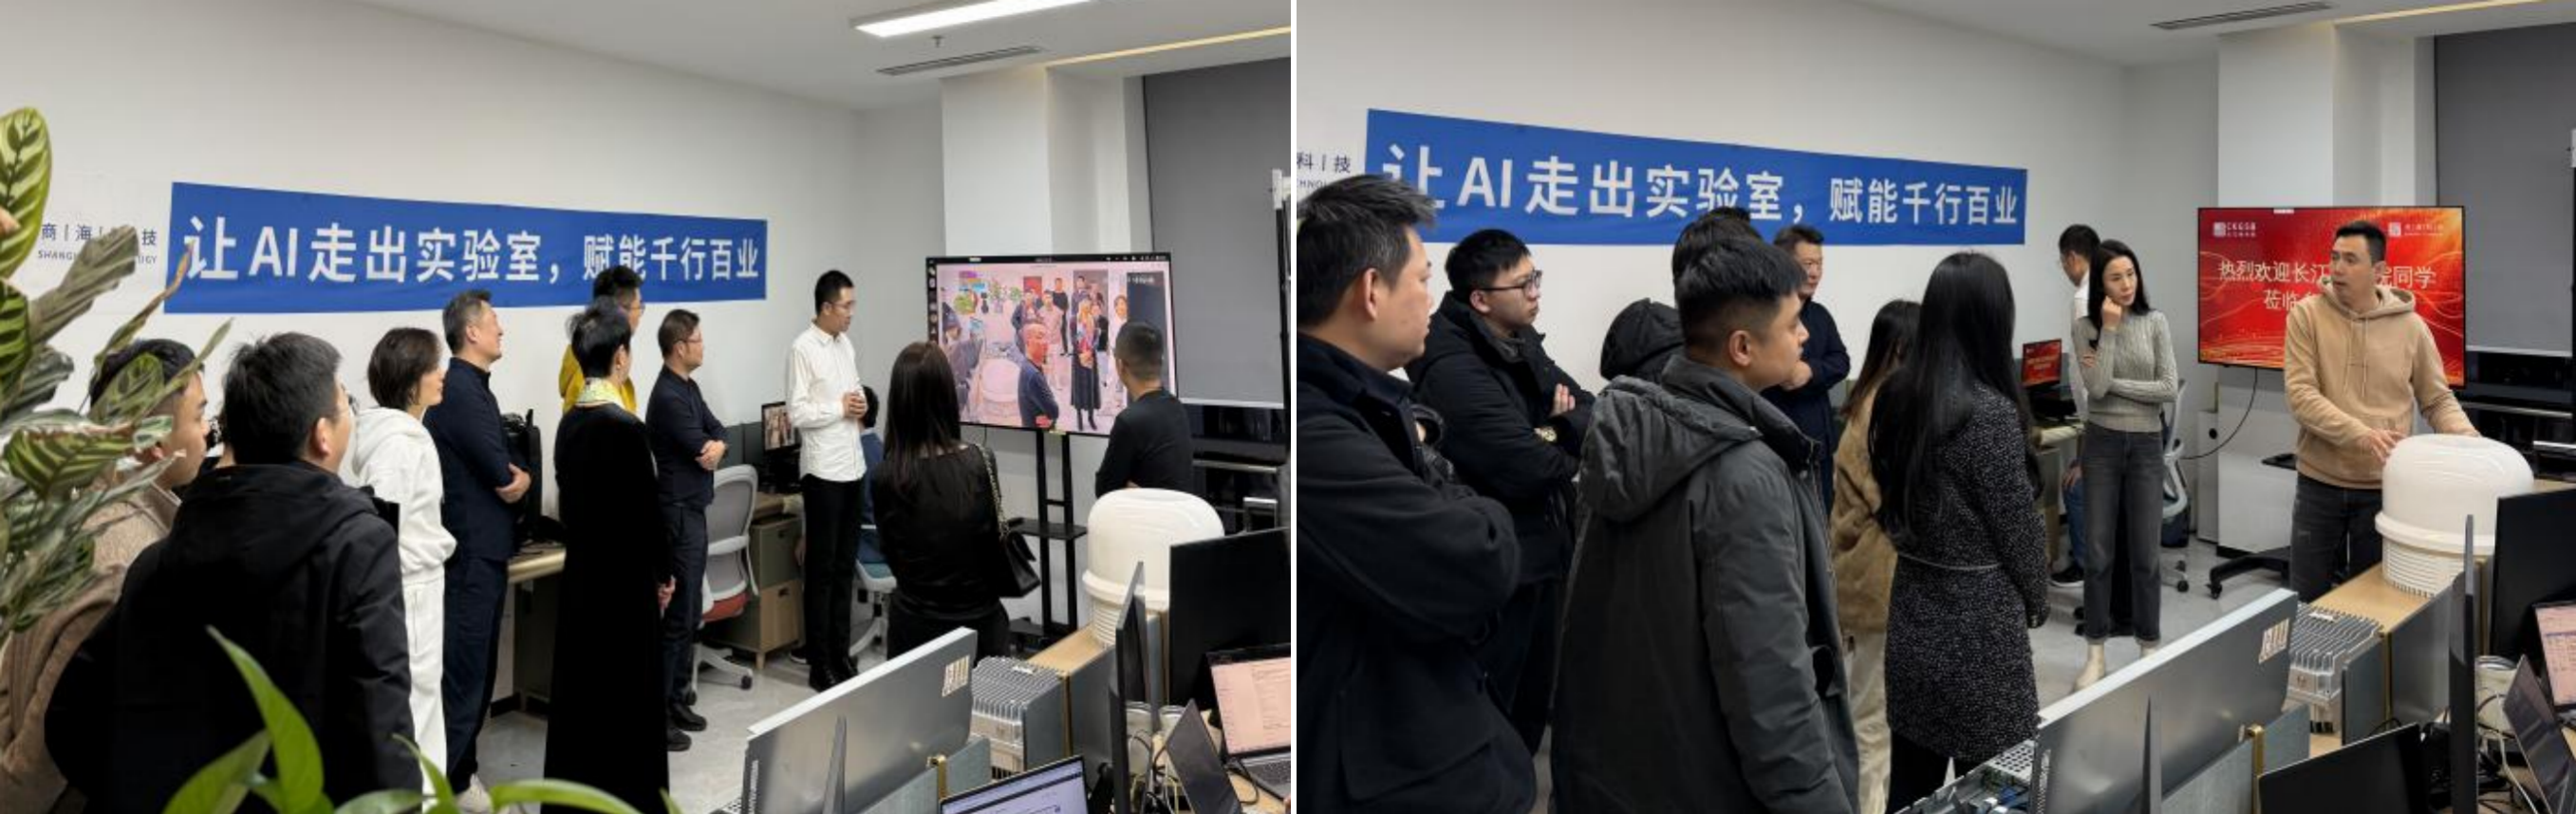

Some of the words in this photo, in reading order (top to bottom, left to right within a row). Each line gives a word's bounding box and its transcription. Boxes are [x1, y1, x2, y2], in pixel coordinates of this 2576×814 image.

[183, 215, 759, 284] 让AI走出实验室，赋能千行百业
[2218, 260, 2437, 289] 热烈欢迎长江同学
